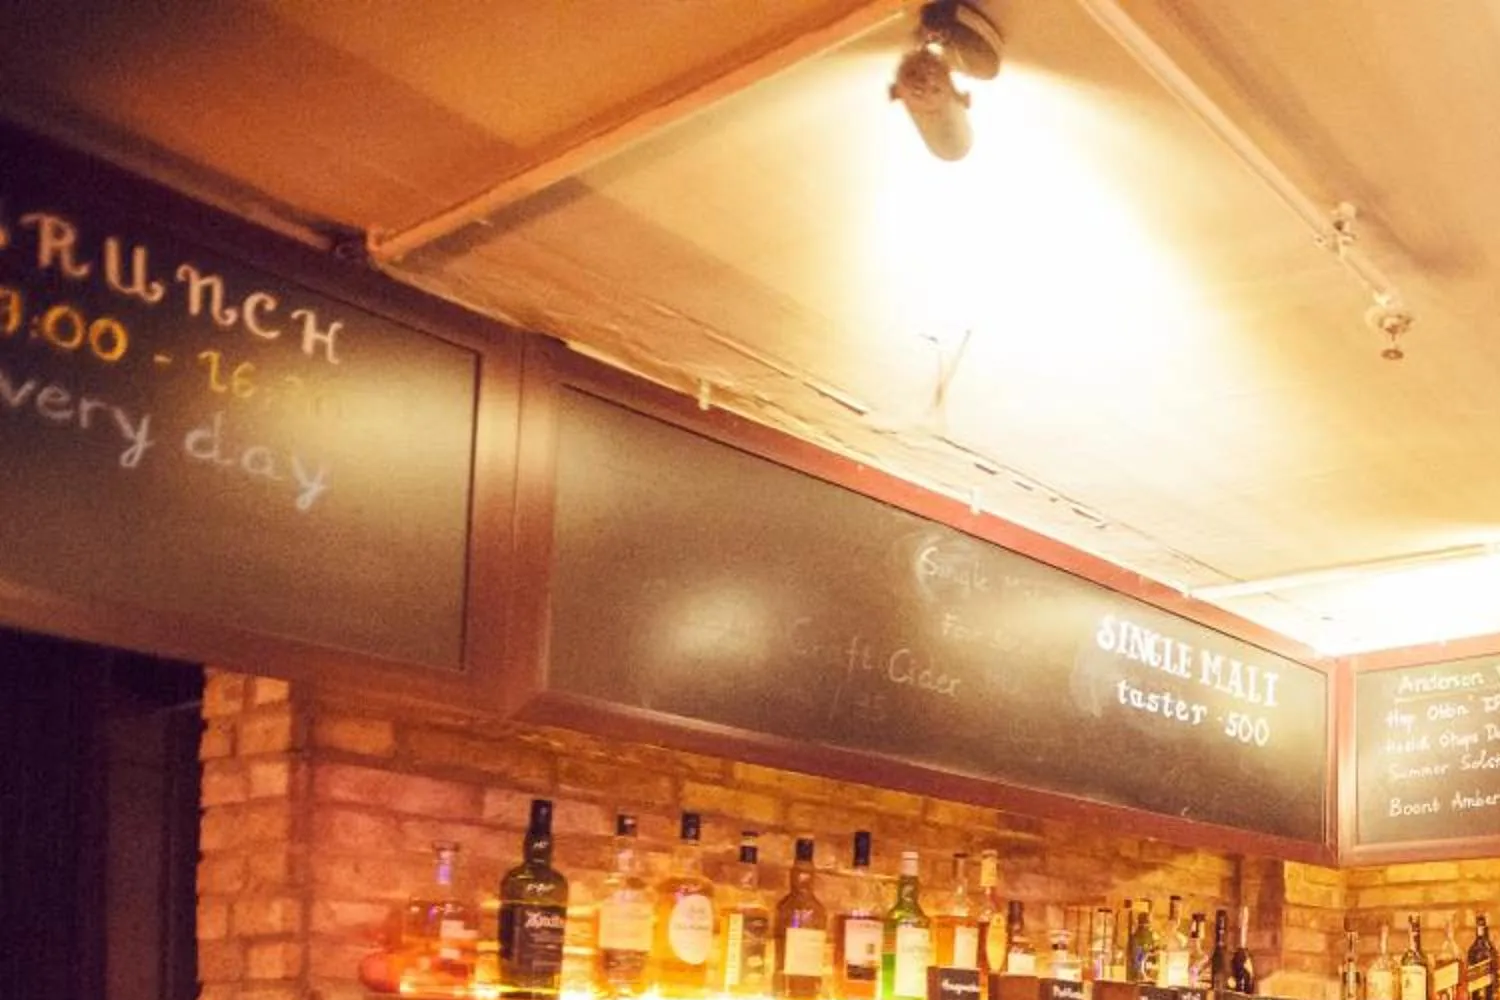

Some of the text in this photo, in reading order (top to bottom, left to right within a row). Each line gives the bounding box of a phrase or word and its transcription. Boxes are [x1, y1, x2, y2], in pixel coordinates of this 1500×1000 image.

[0, 211, 344, 365] RUNCH
[184, 411, 329, 510] day
[1096, 612, 1193, 679] SINGLE
[1199, 650, 1279, 707] MALT
[1116, 680, 1207, 725] taster
[1225, 712, 1269, 747] 500
[1451, 790, 1500, 812] Amber
